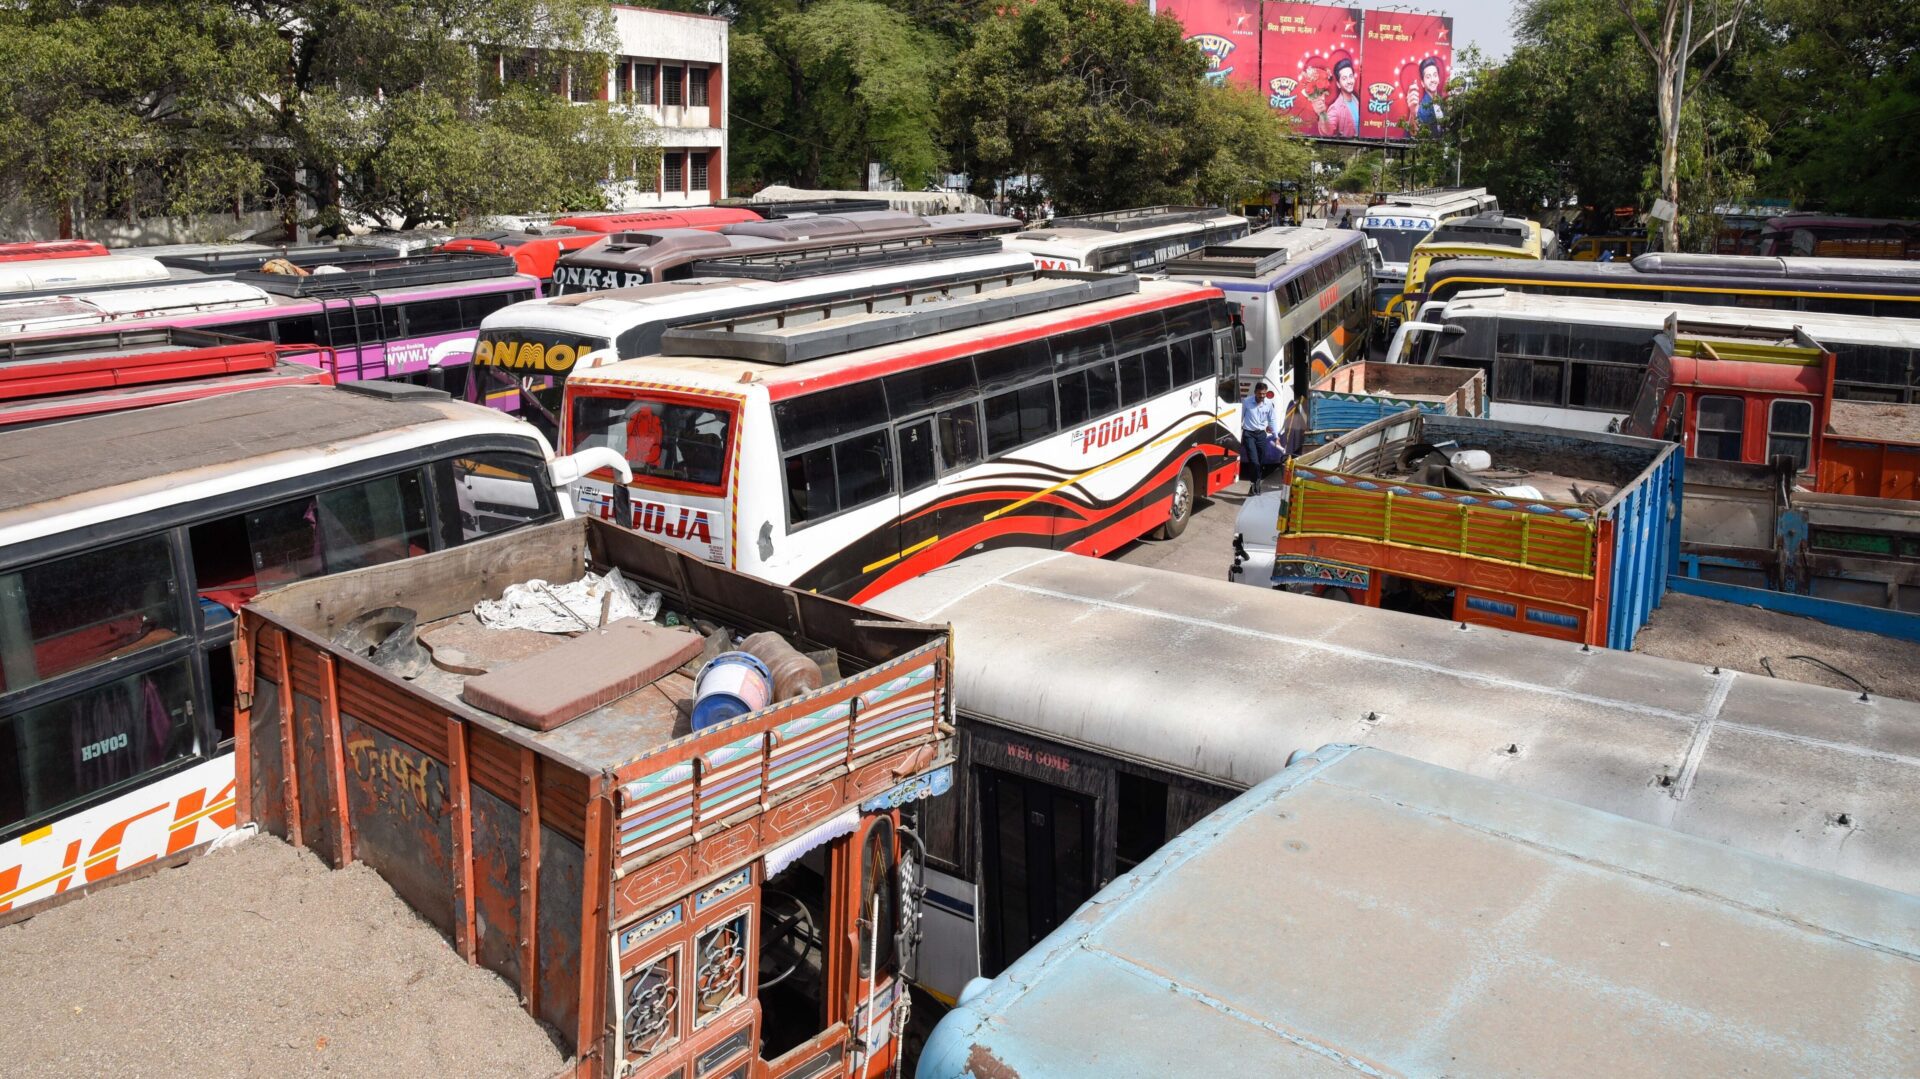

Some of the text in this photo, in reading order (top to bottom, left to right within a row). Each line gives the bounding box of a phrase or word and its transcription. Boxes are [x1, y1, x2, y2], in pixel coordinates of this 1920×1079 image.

[1269, 77, 1299, 94] कृष्णा
[1368, 82, 1395, 100] कृष्णा
[1366, 217, 1434, 231] BABA
[554, 266, 645, 289] ONKAR
[1082, 407, 1149, 455] POOJA
[577, 485, 600, 499] NEW
[81, 733, 128, 762] COACH
